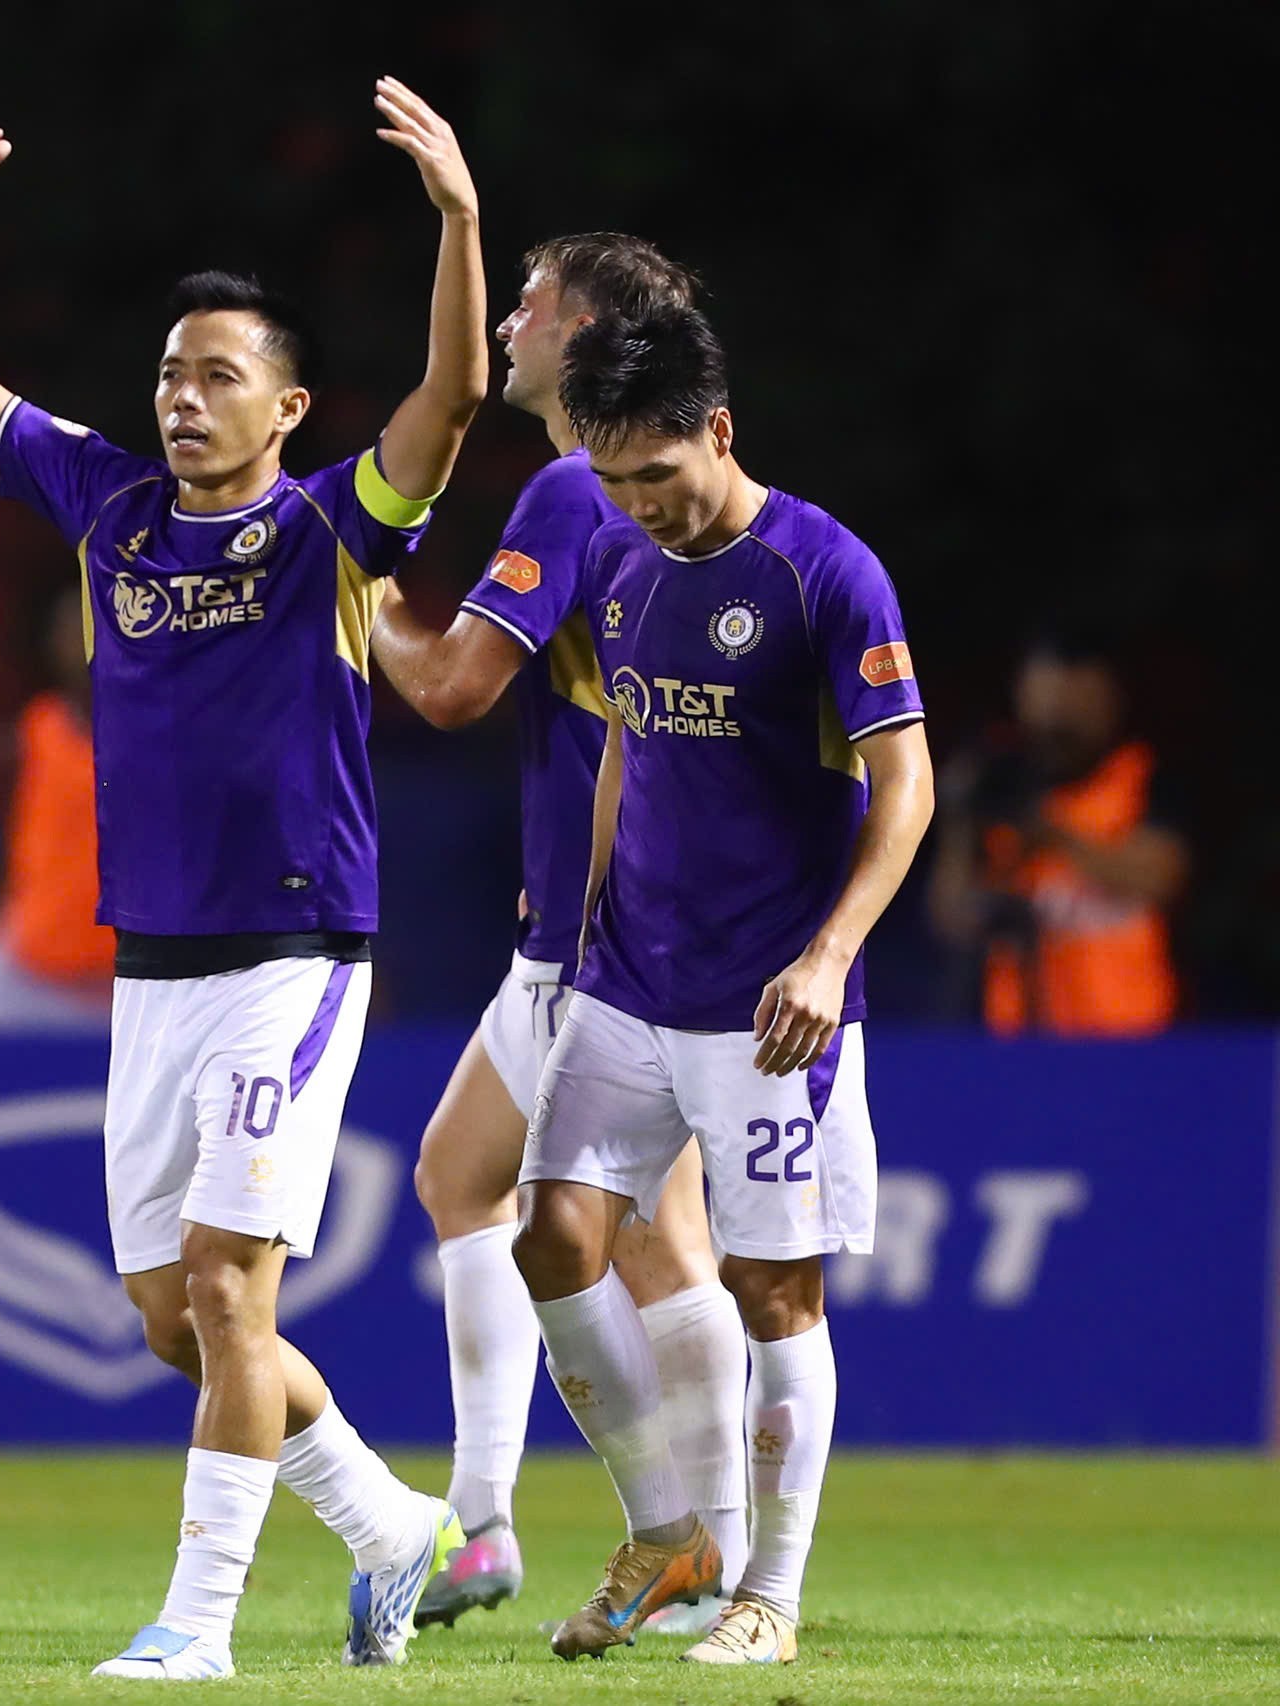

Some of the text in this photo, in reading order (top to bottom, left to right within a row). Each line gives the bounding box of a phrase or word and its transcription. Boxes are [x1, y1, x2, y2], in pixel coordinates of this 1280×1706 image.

[170, 568, 267, 612] T&T
[169, 602, 266, 632] HOMES
[653, 677, 735, 718] T&T
[653, 714, 742, 737] HOMES
[226, 1071, 284, 1139] 10
[746, 1116, 814, 1183] 22
